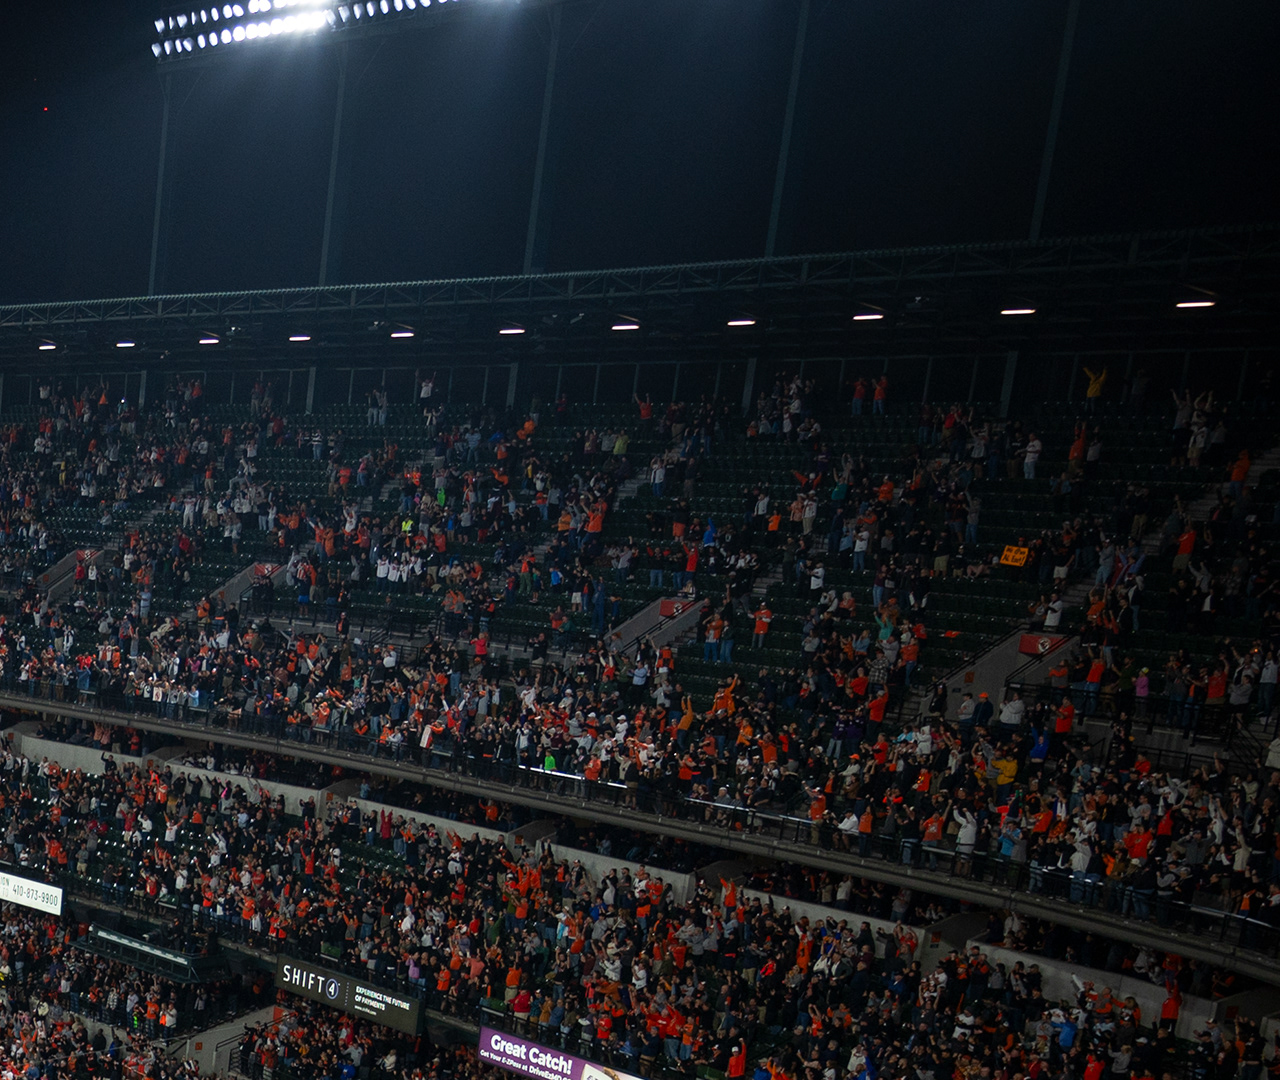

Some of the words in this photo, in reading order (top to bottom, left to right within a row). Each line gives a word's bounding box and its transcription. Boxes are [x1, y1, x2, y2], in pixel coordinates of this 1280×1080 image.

[13, 884, 58, 906] 410-873-9900
[283, 964, 325, 994] SHIFT
[356, 986, 382, 1001] EXPERIENCE
[392, 998, 410, 1010] FUTURE
[491, 1034, 527, 1061] Great
[529, 1047, 572, 1074] Catch!
